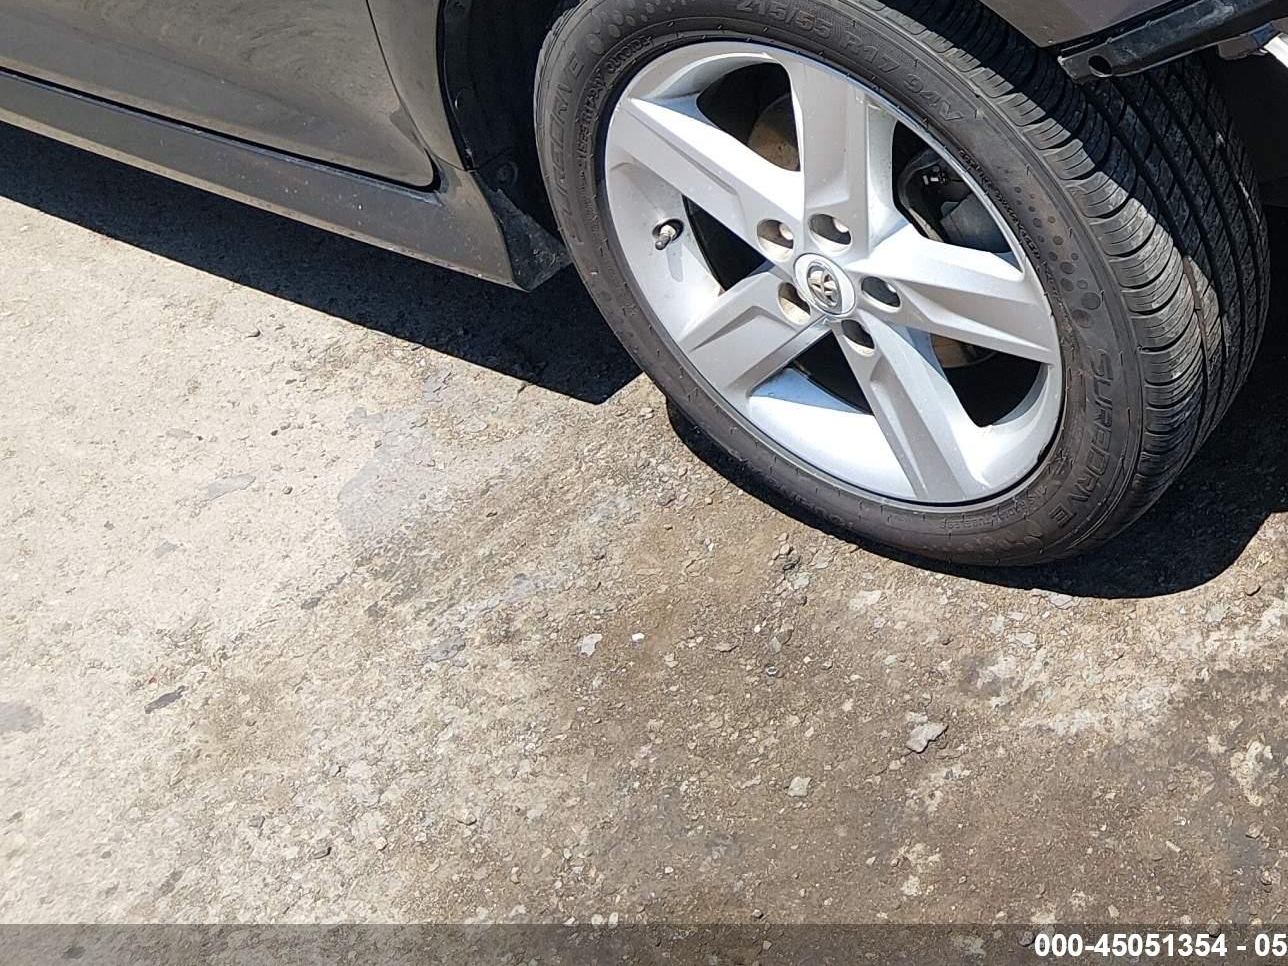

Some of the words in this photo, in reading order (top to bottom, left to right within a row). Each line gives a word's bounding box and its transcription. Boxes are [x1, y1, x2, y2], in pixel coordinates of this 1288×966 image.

[839, 30, 902, 74] R17
[902, 73, 966, 124] 94V
[1049, 348, 1114, 530] SUREDRIVE
